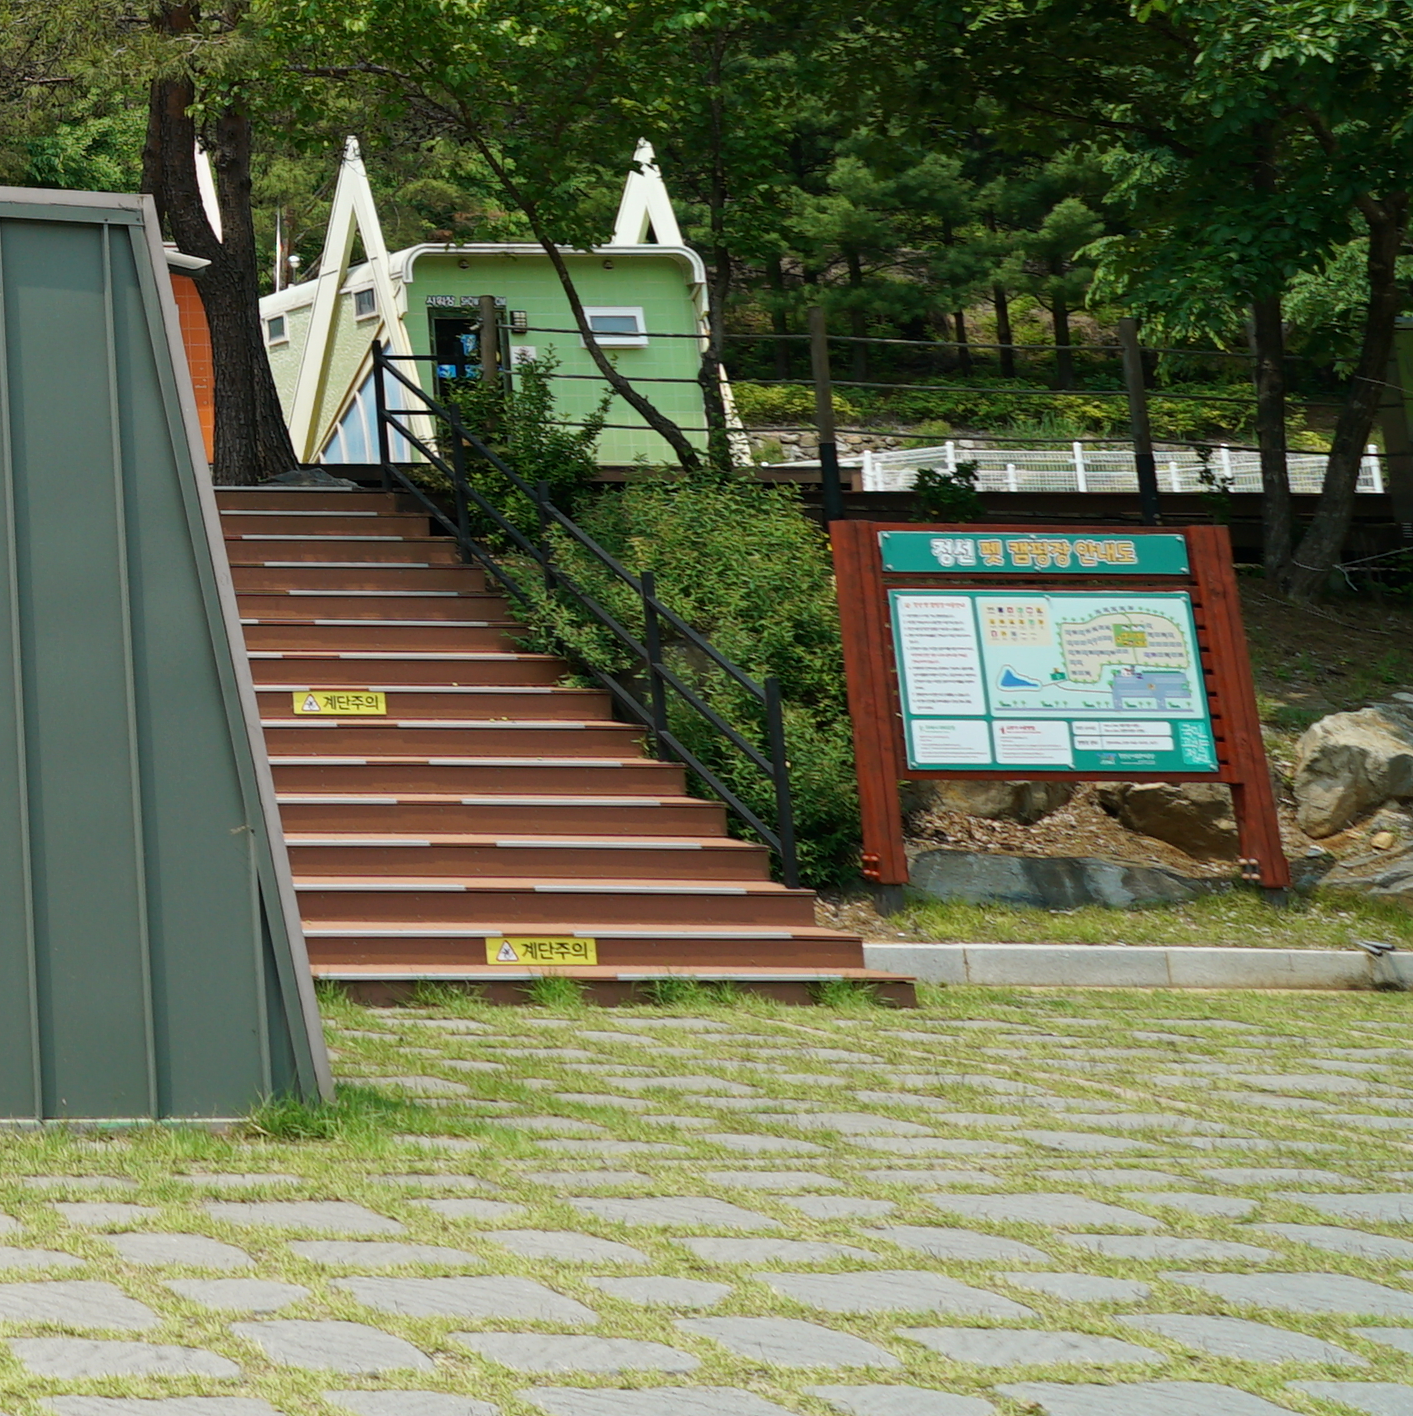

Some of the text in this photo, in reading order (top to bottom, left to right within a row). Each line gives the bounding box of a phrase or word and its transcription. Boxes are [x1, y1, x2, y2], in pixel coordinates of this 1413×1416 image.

[930, 539, 1138, 569] 정선 펫 캠핑장 안내도
[323, 694, 379, 711] 계단주의
[520, 941, 589, 961] 계단주의
